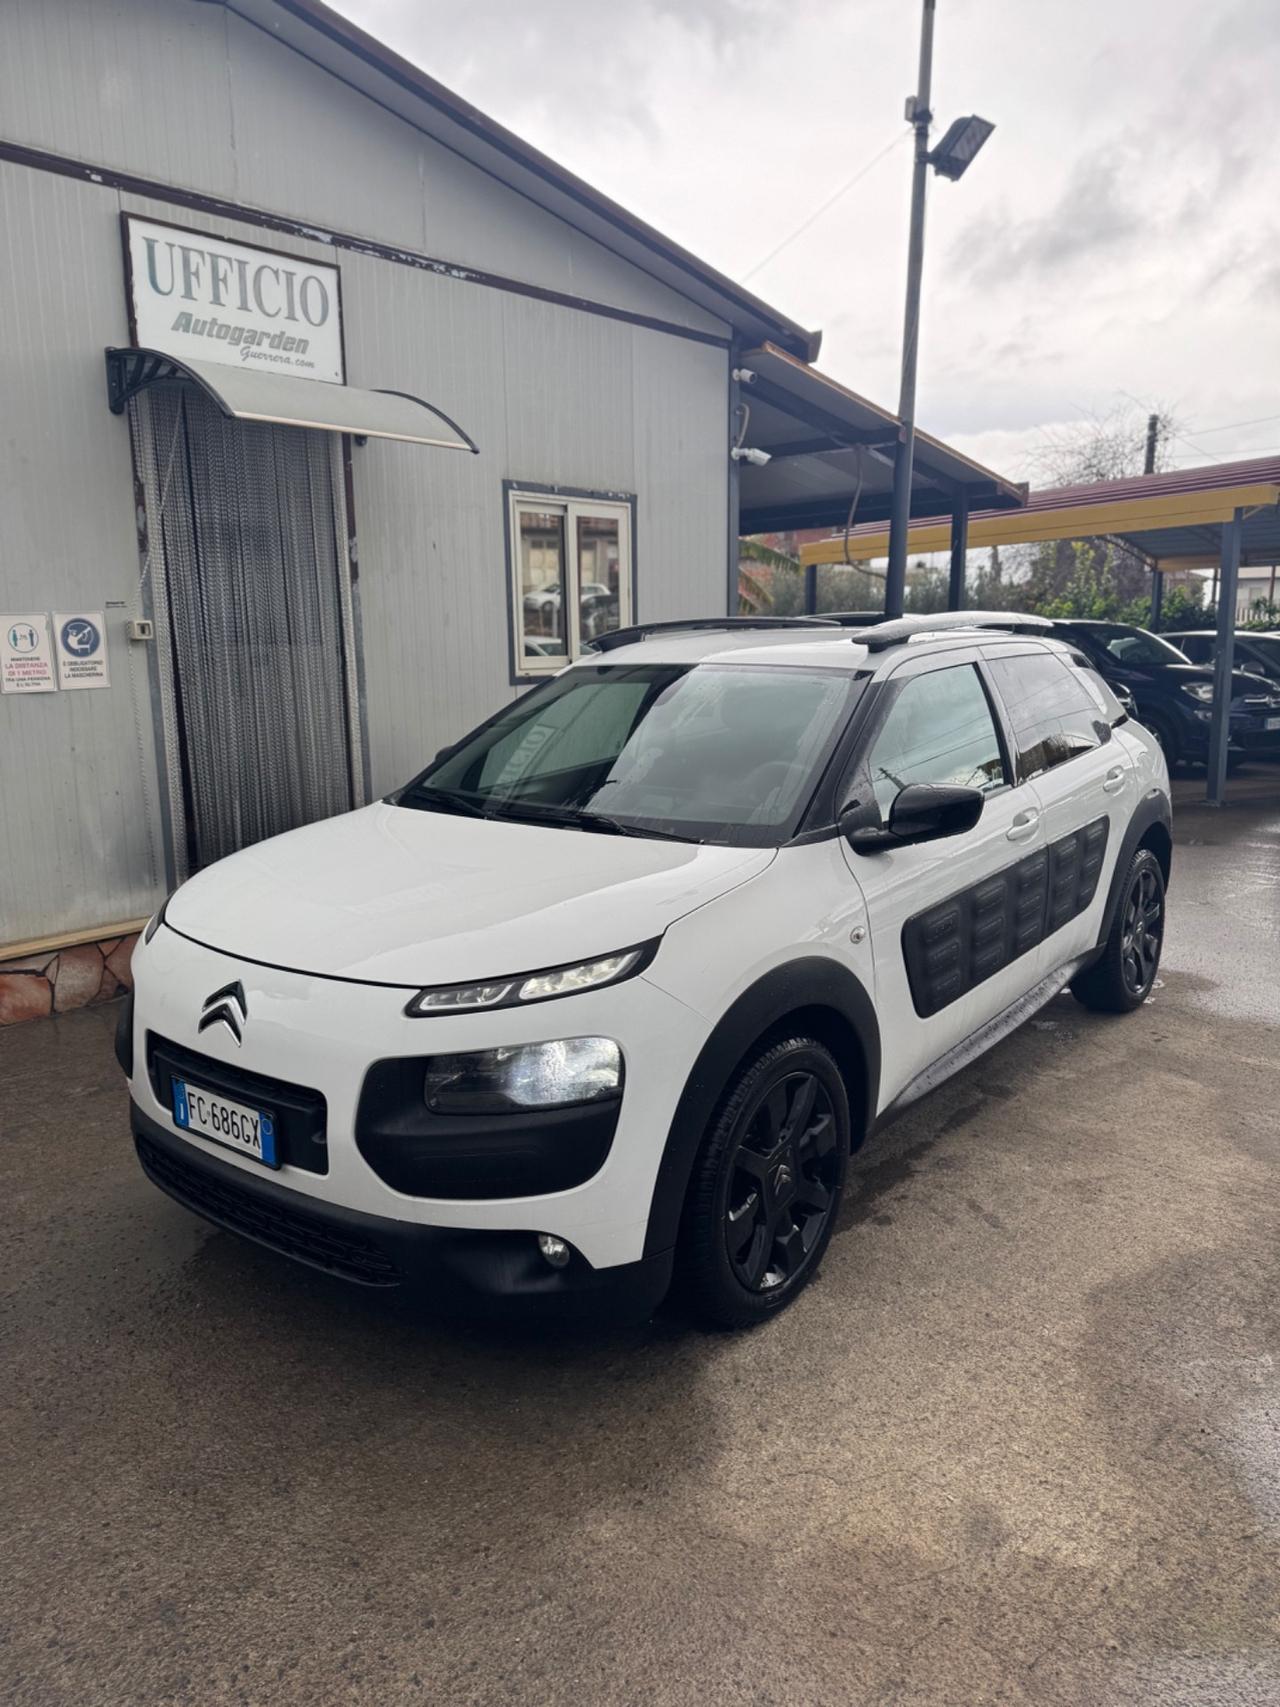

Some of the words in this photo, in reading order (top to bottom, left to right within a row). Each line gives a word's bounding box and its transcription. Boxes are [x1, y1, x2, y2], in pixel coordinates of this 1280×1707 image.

[141, 236, 329, 327] UFFICIO
[171, 311, 310, 355] Autogarden
[239, 345, 315, 369] Guerrera.com
